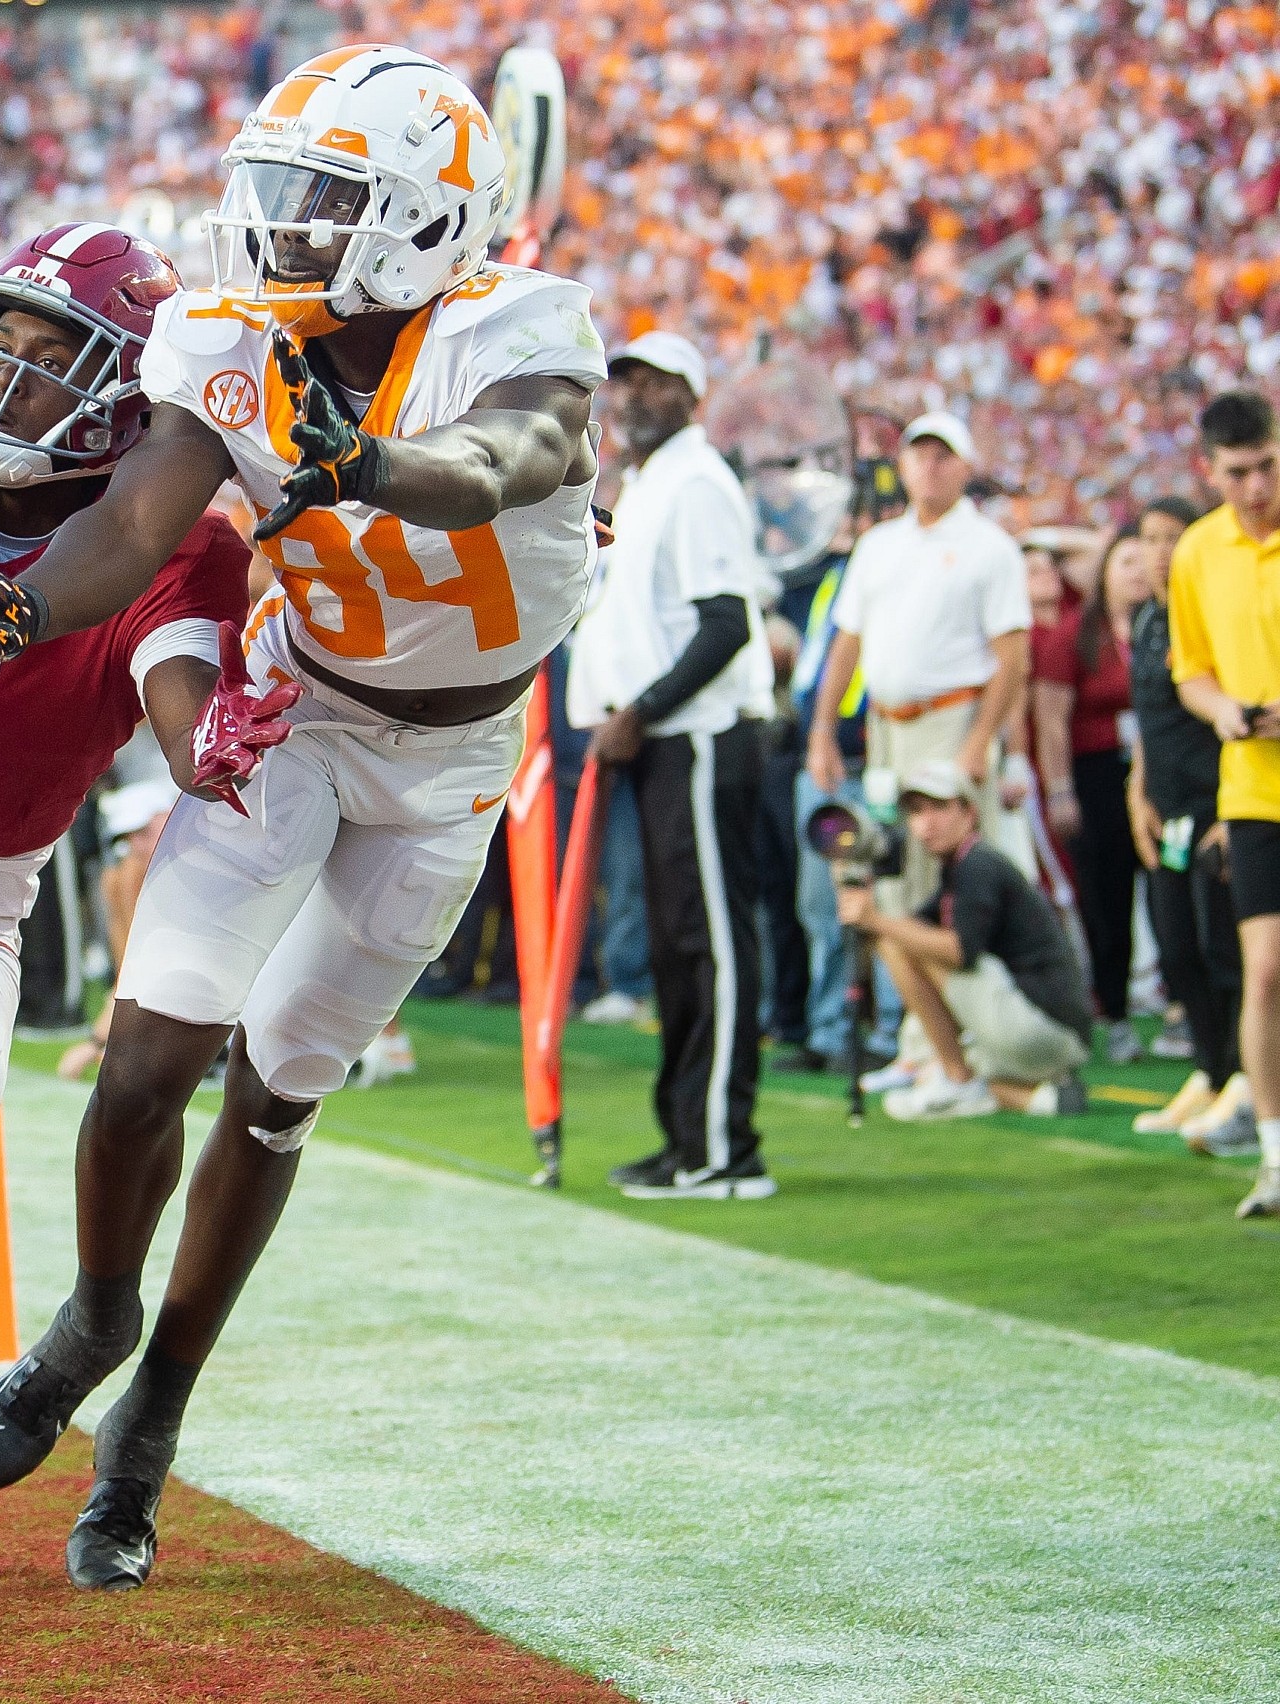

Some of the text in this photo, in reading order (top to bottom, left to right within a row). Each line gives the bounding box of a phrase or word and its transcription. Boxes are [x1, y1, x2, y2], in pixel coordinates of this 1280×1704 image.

[262, 121, 284, 132] VOLS
[418, 88, 489, 193] T
[17, 268, 53, 288] BAMA
[207, 373, 256, 426] SEC
[256, 505, 521, 658] 84
